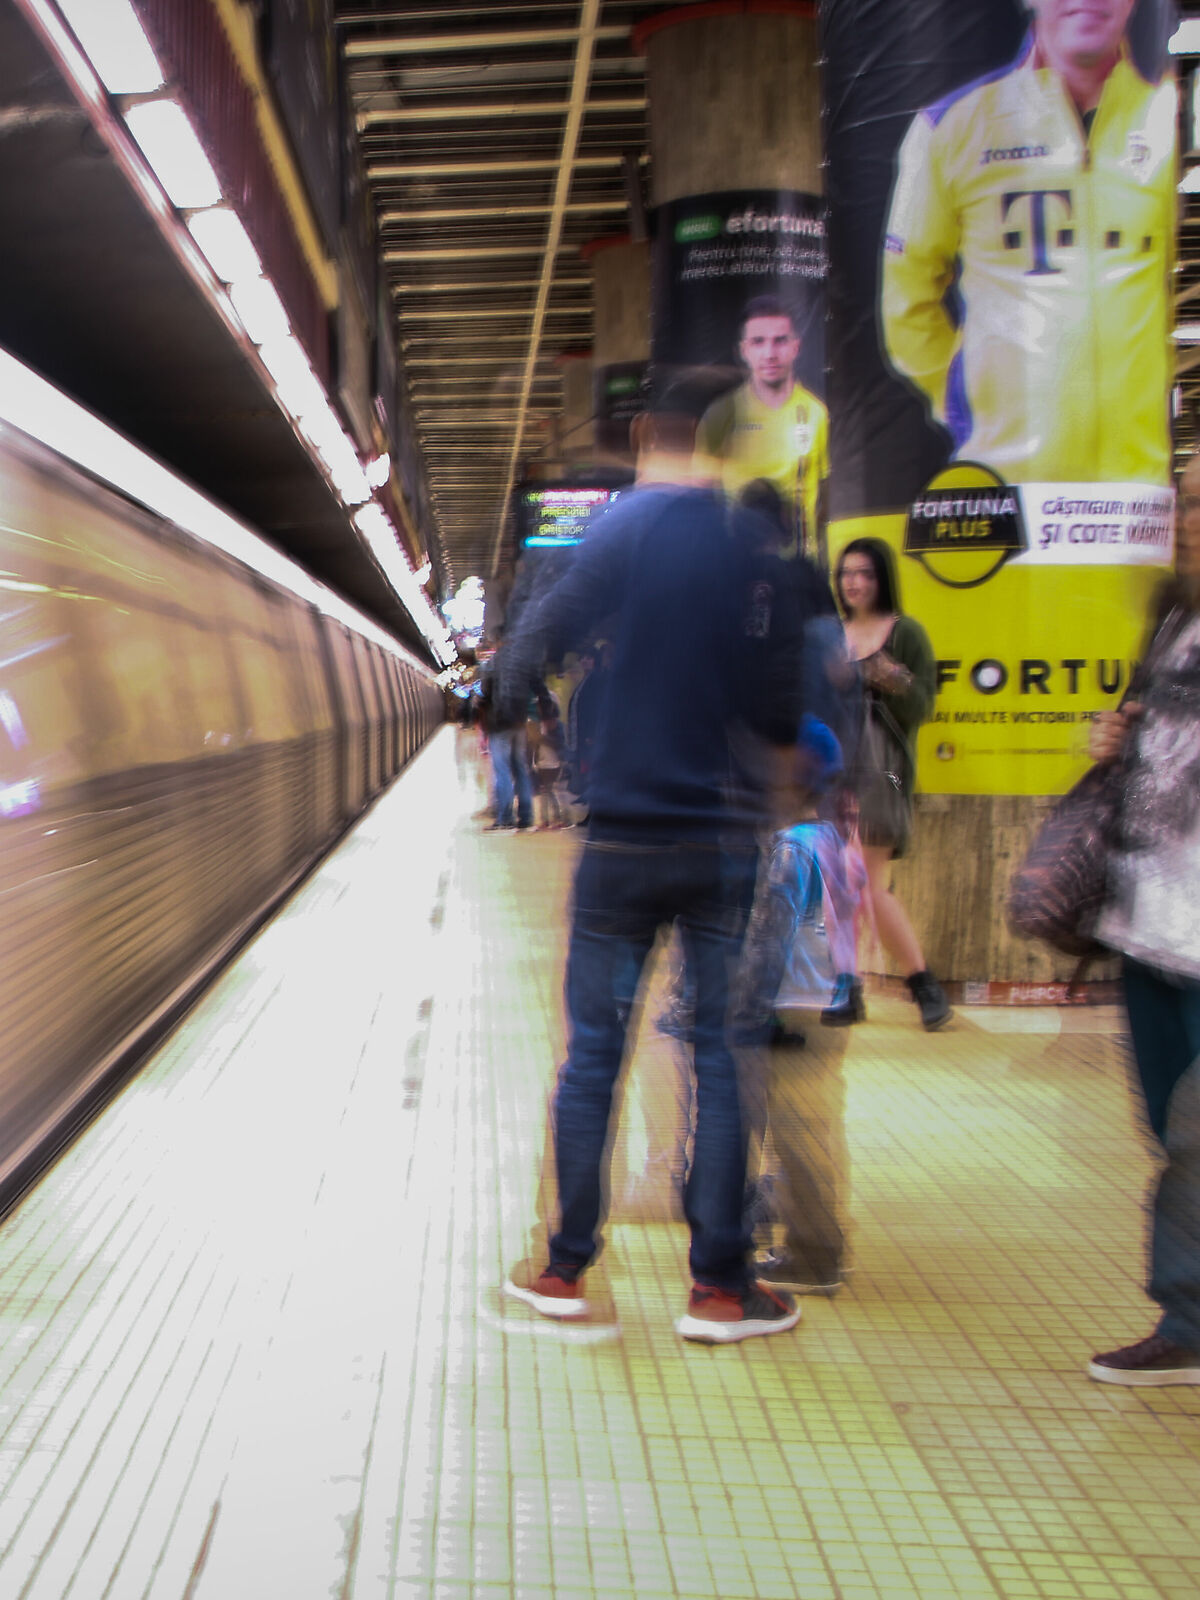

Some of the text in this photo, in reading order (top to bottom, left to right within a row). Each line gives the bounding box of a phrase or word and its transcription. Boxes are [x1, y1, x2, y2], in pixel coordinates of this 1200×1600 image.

[912, 498, 1018, 520] FORTUNA
[935, 520, 993, 538] PLUS
[1067, 523, 1122, 544] COTE
[936, 658, 1122, 695] FORTU
